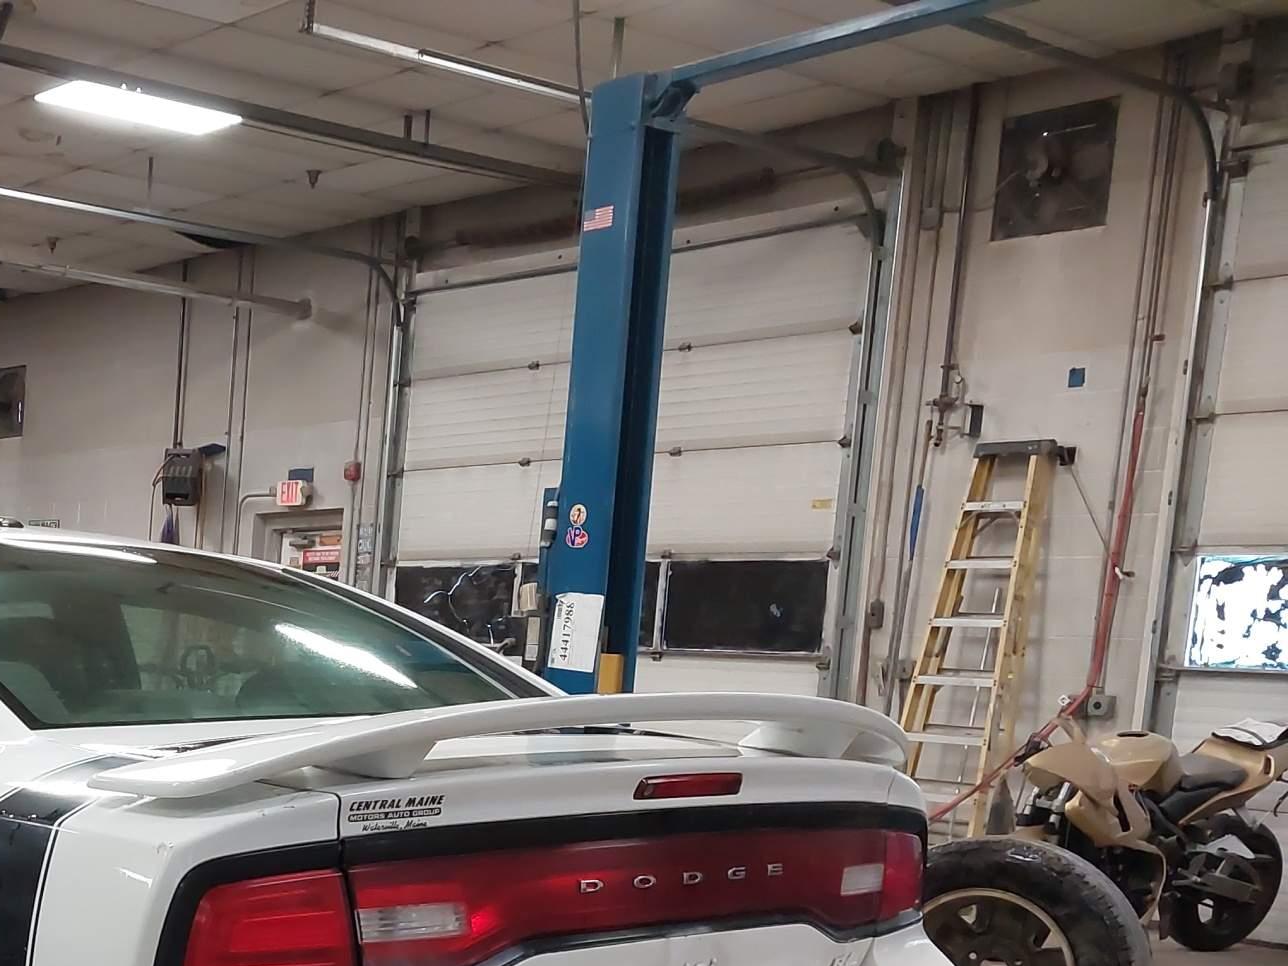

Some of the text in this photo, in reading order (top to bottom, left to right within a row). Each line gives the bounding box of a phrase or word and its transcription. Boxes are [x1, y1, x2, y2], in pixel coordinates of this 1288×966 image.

[280, 481, 299, 504] EXIT
[349, 795, 445, 812] CENTRAL MAINE
[349, 808, 441, 822] MOTORS AUTO GROUP
[579, 863, 784, 894] DODGE
